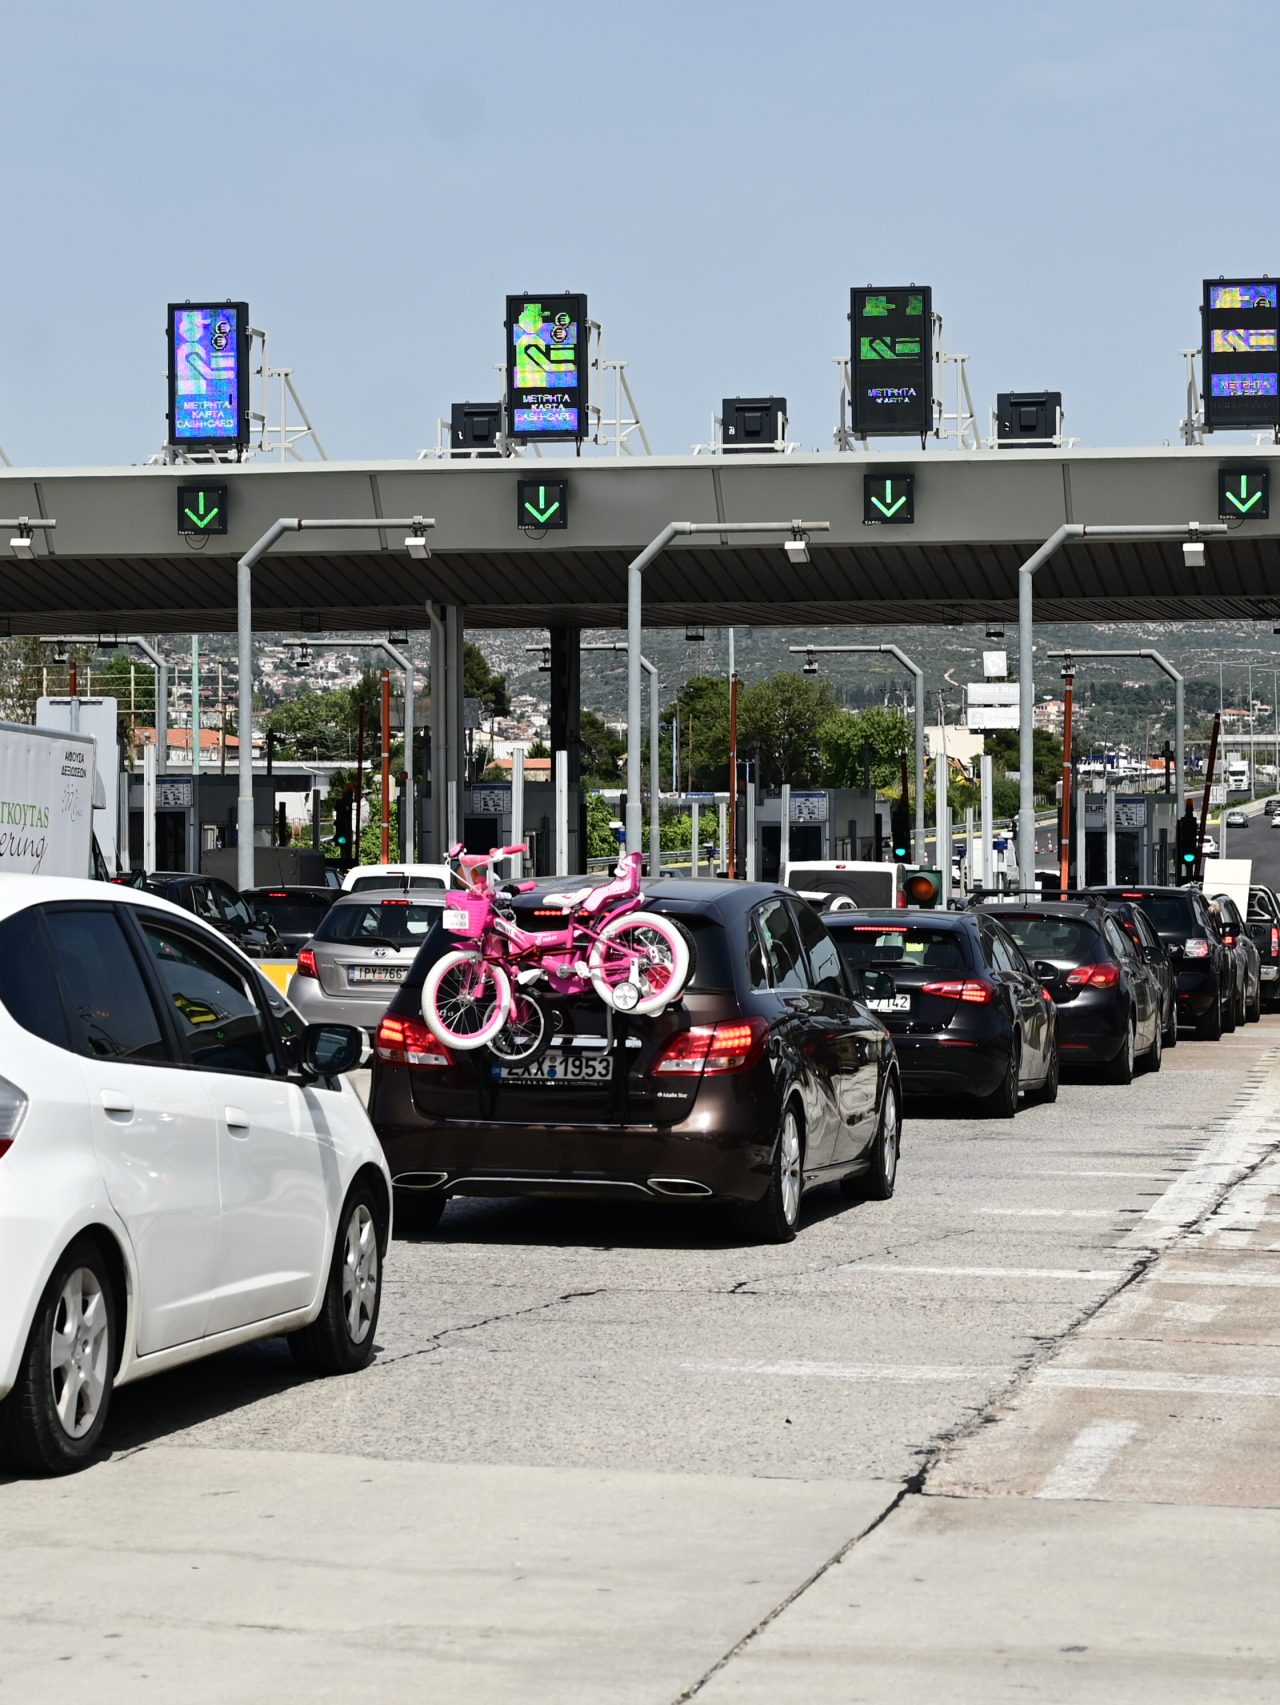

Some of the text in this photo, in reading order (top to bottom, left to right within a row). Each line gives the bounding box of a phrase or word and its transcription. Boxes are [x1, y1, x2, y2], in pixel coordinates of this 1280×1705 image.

[522, 394, 571, 403] ΜΕΤΡΗΤΑ
[183, 401, 231, 410] ΜΕΤΡΗΤΑ
[192, 411, 225, 419] ΚΑΡΤΑ
